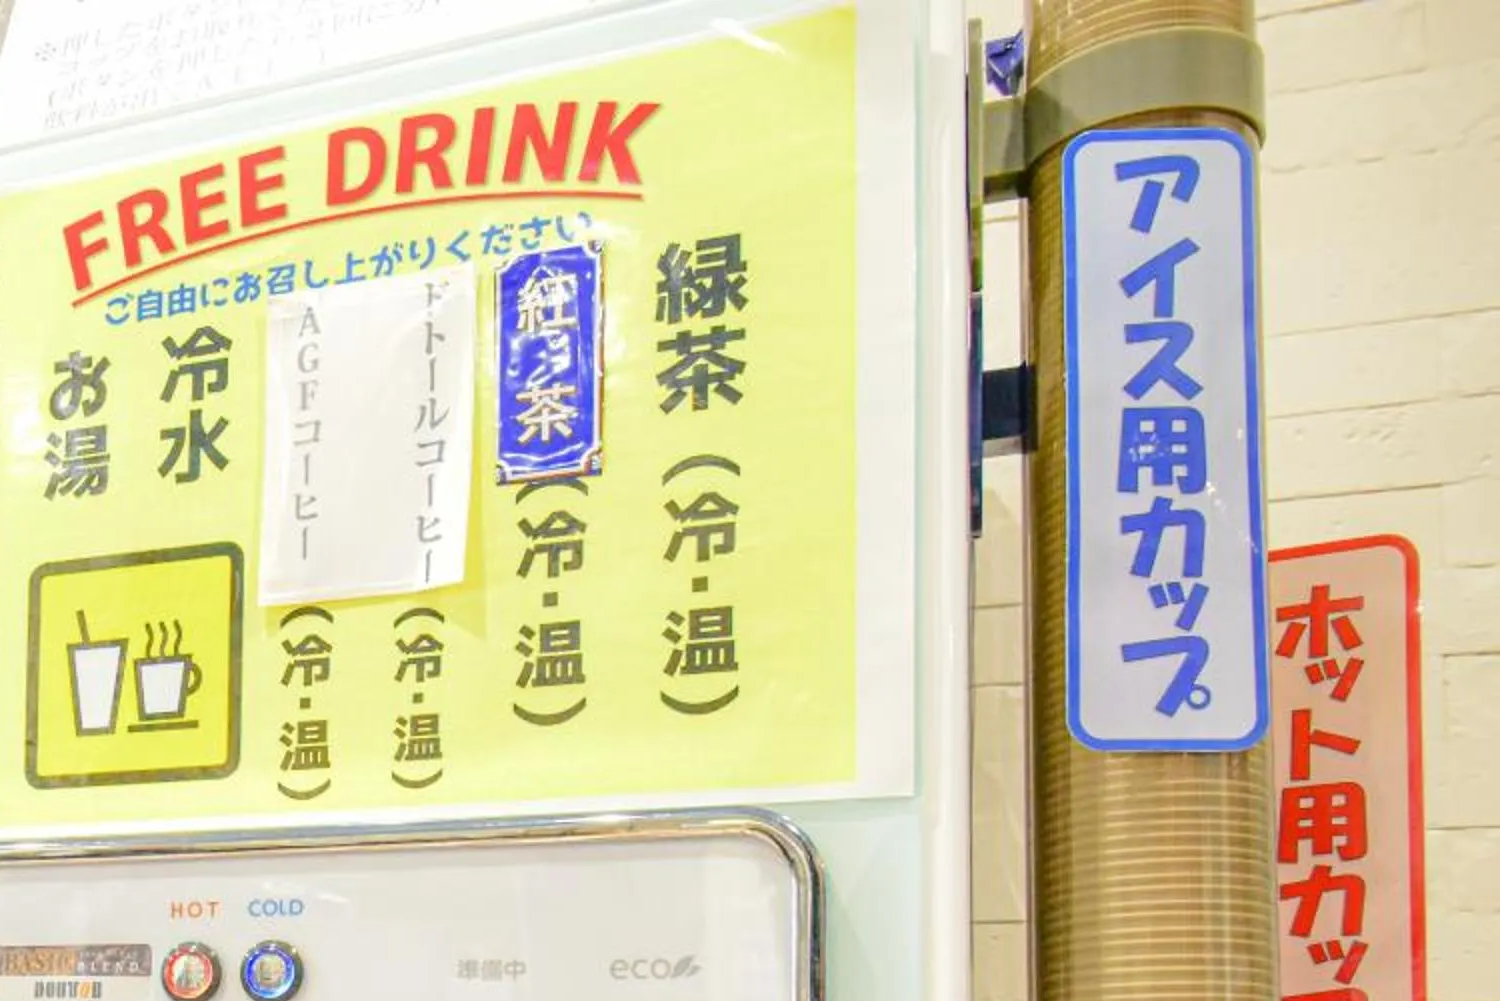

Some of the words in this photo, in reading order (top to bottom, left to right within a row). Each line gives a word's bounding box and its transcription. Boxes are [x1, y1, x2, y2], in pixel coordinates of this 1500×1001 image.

[62, 146, 289, 292] FREE
[326, 101, 661, 208] DRINK
[105, 210, 592, 326] ご自由にお召し上がりください
[43, 350, 111, 502] お湯
[157, 325, 232, 485] 冷水
[412, 280, 451, 584] ドトールコーヒー
[1116, 155, 1211, 717] アイス用カップ
[170, 901, 220, 919] HOT
[248, 899, 304, 917] COLD
[610, 958, 672, 980] eco
